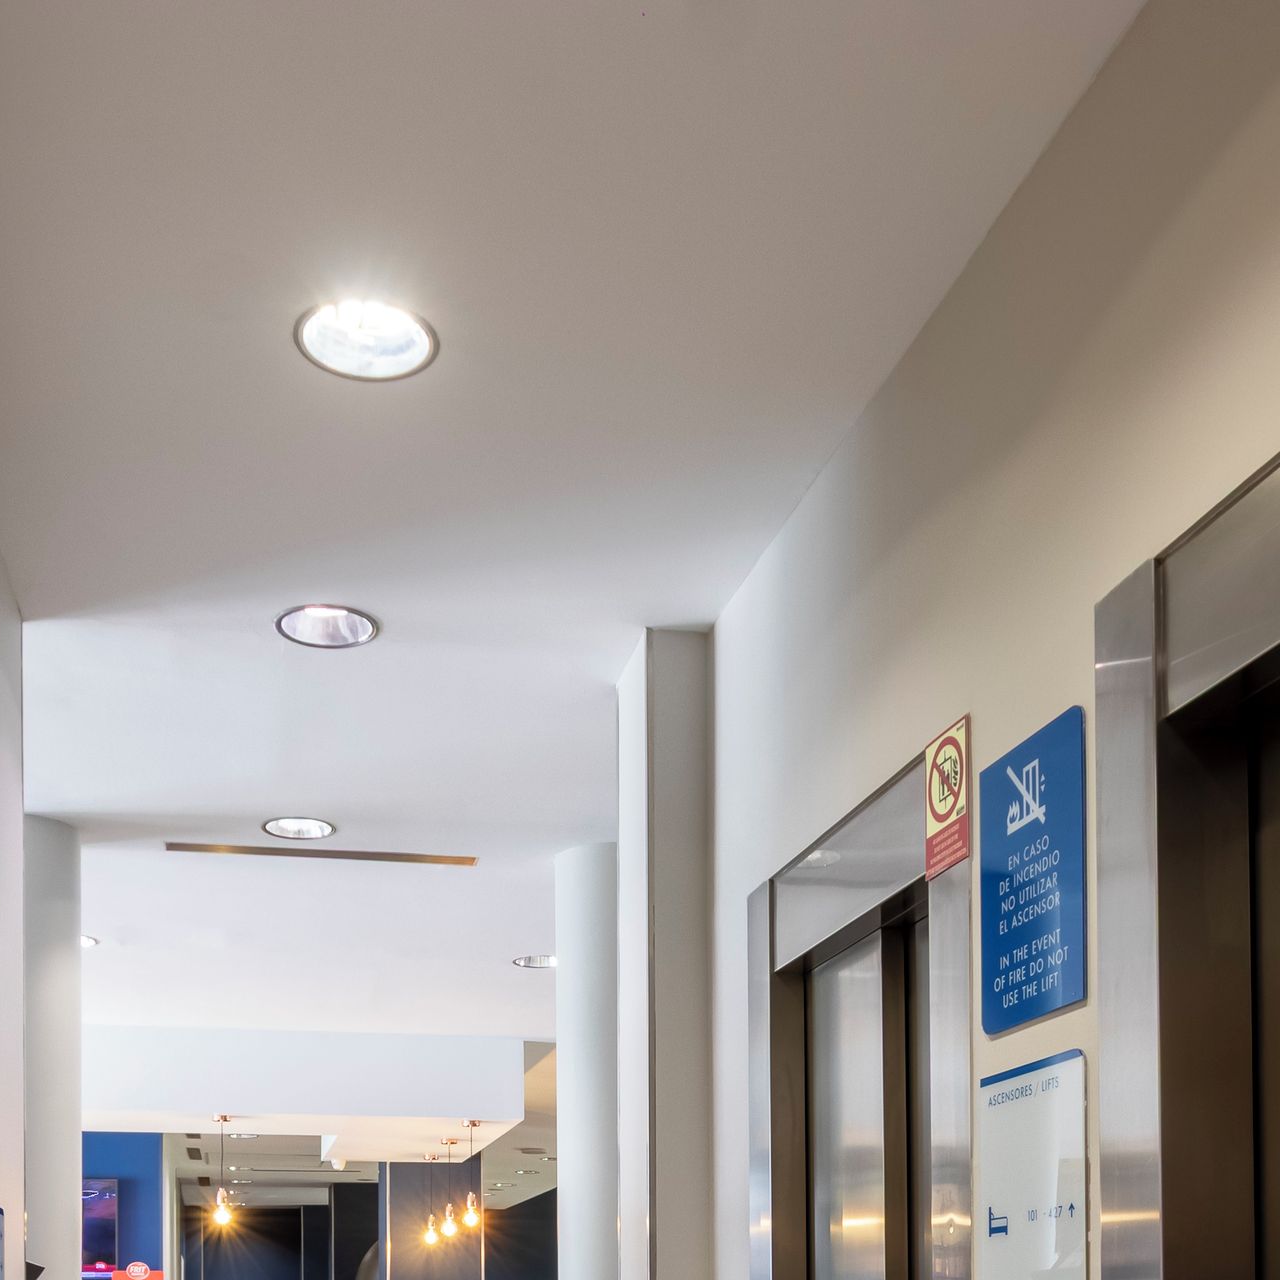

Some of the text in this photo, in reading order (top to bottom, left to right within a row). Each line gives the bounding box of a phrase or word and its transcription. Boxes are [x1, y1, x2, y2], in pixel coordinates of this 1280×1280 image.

[1000, 850, 1060, 896] DE INCENDIO
[1008, 835, 1050, 871] EN CASO
[999, 891, 1060, 935] EL ASCENSOR
[1001, 872, 1058, 915] NO UTILIZAR
[994, 945, 1069, 992] OF FIRE DO NOT
[1000, 928, 1061, 971] IN THE EVENT
[1002, 971, 1059, 1008] USE THE LIFT
[987, 1083, 1033, 1108] ASCENSORES
[1041, 1076, 1059, 1092] LIFTS
